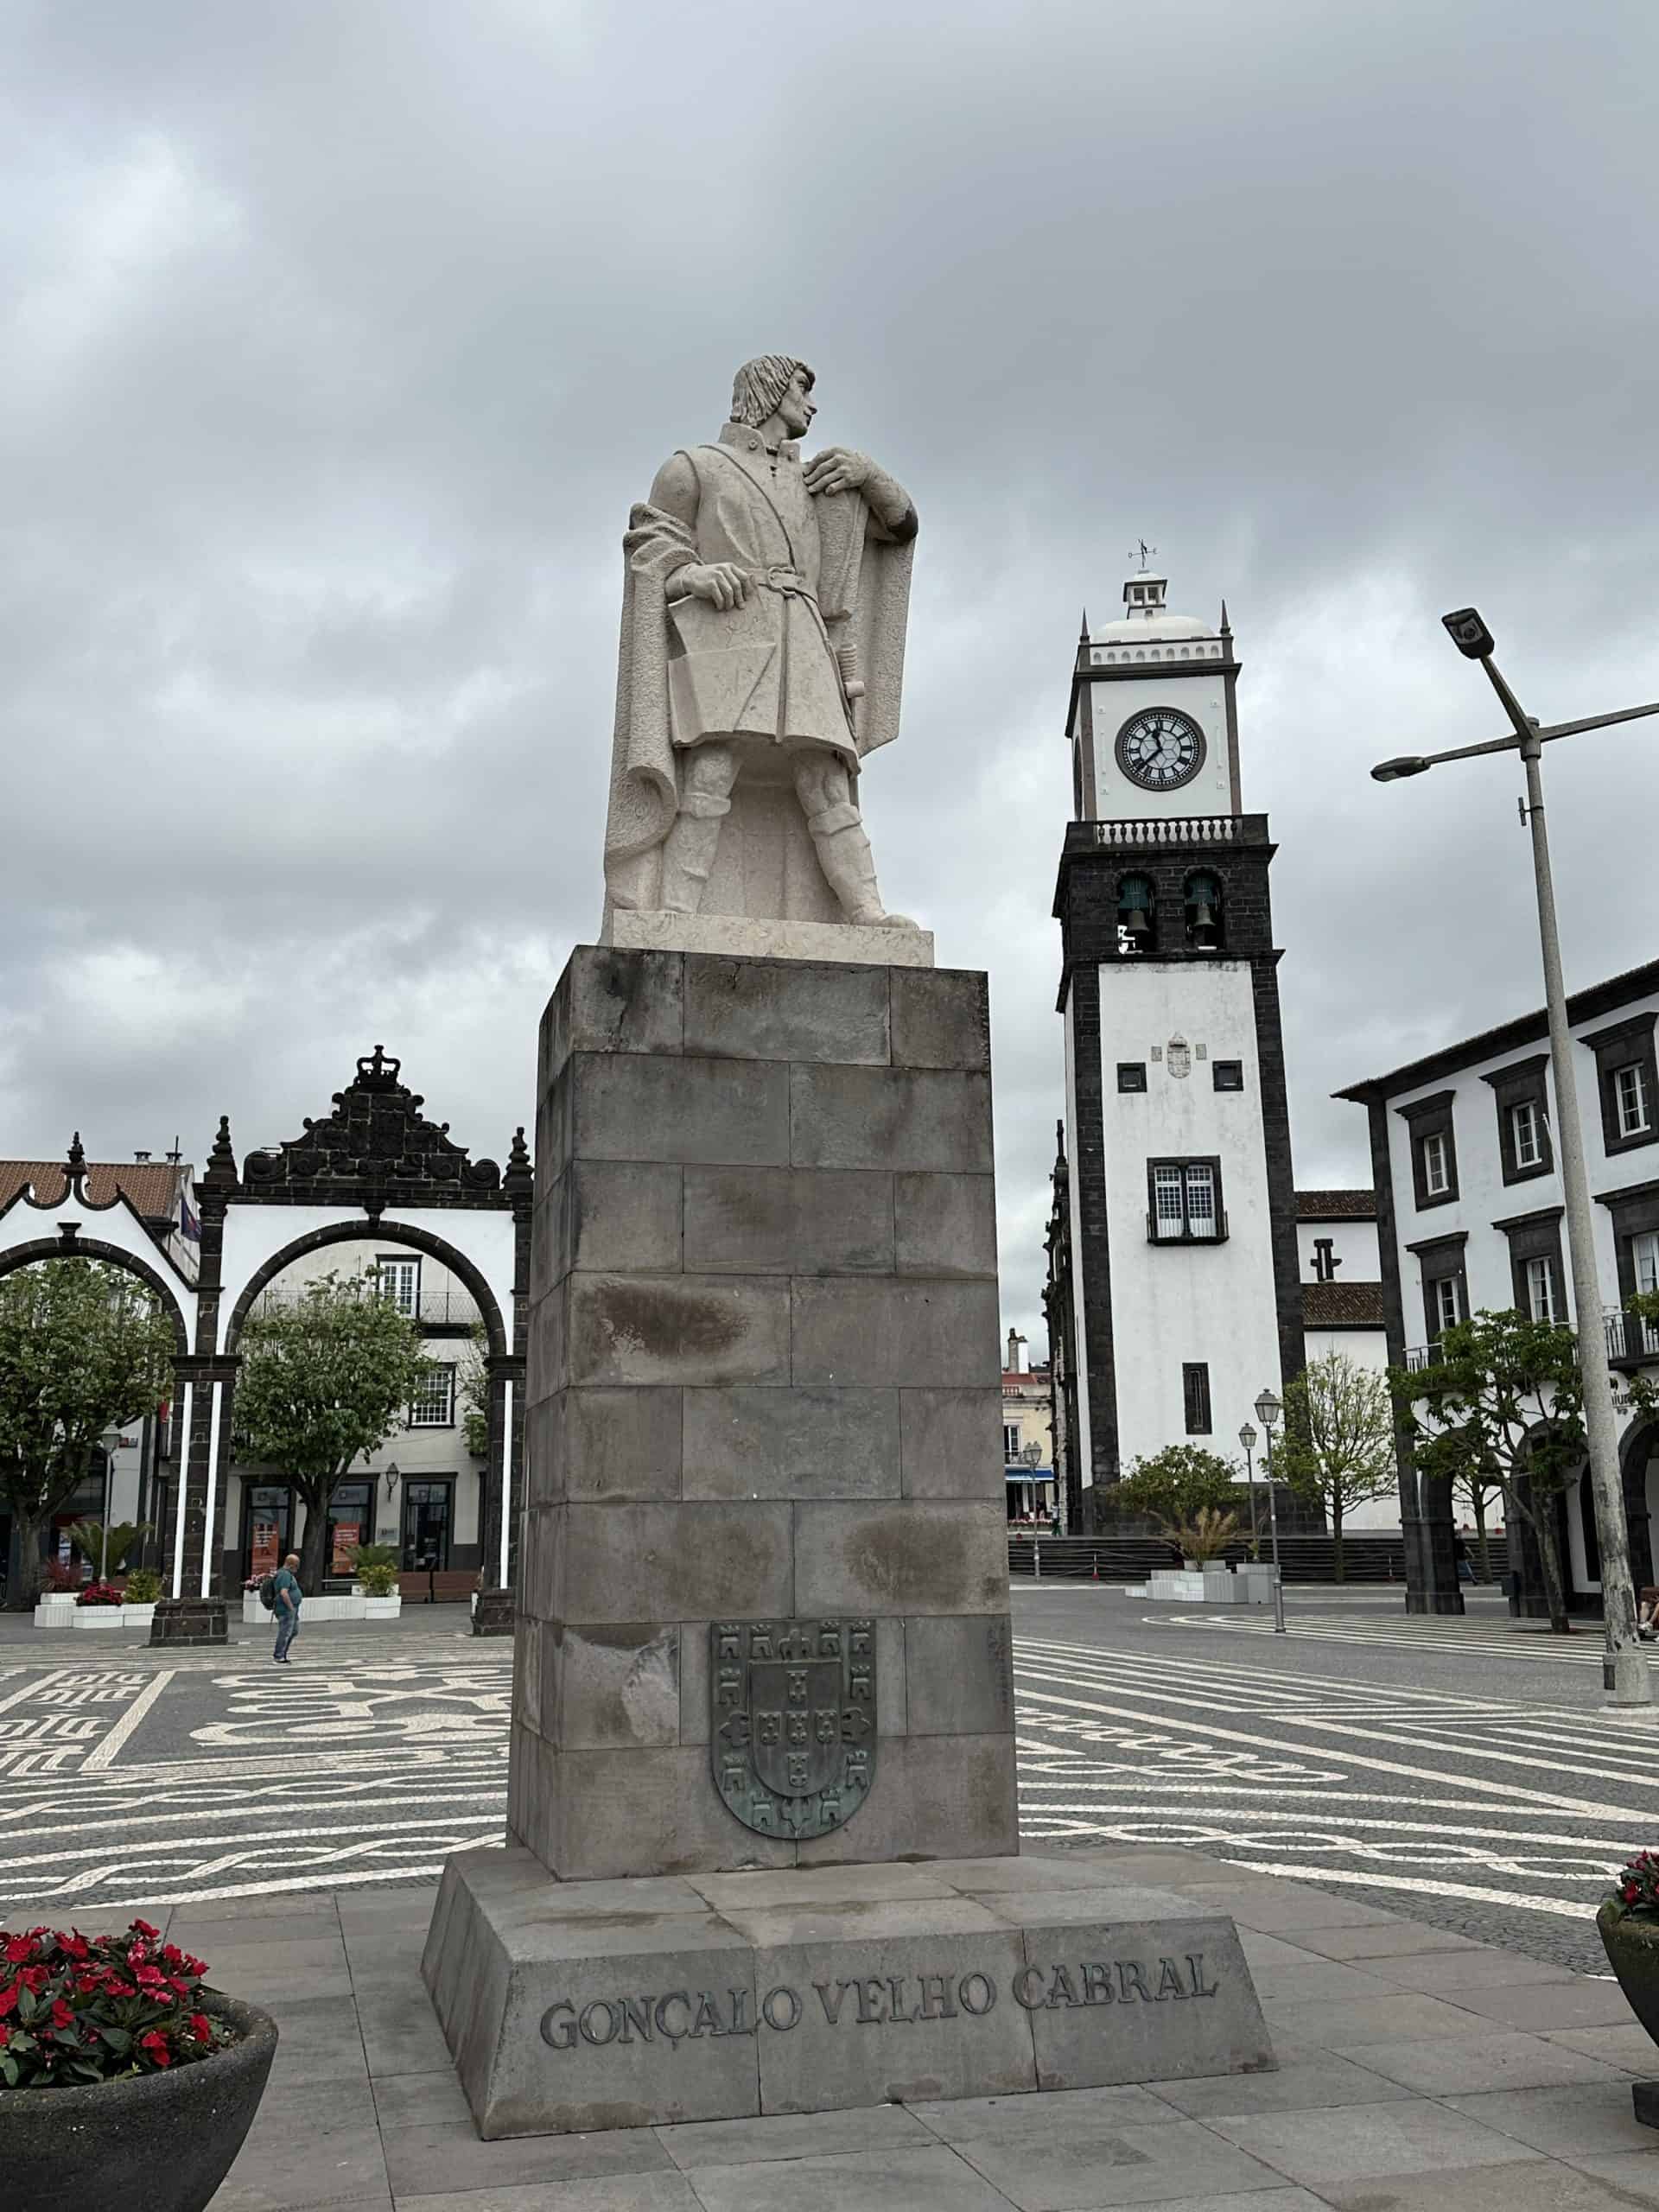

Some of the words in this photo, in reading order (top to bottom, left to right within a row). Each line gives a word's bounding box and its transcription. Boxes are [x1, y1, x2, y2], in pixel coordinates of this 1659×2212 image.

[539, 1986, 803, 2050] GONÇALO
[811, 1970, 998, 2024] VELHO
[1012, 1953, 1221, 2010] CABRAL
